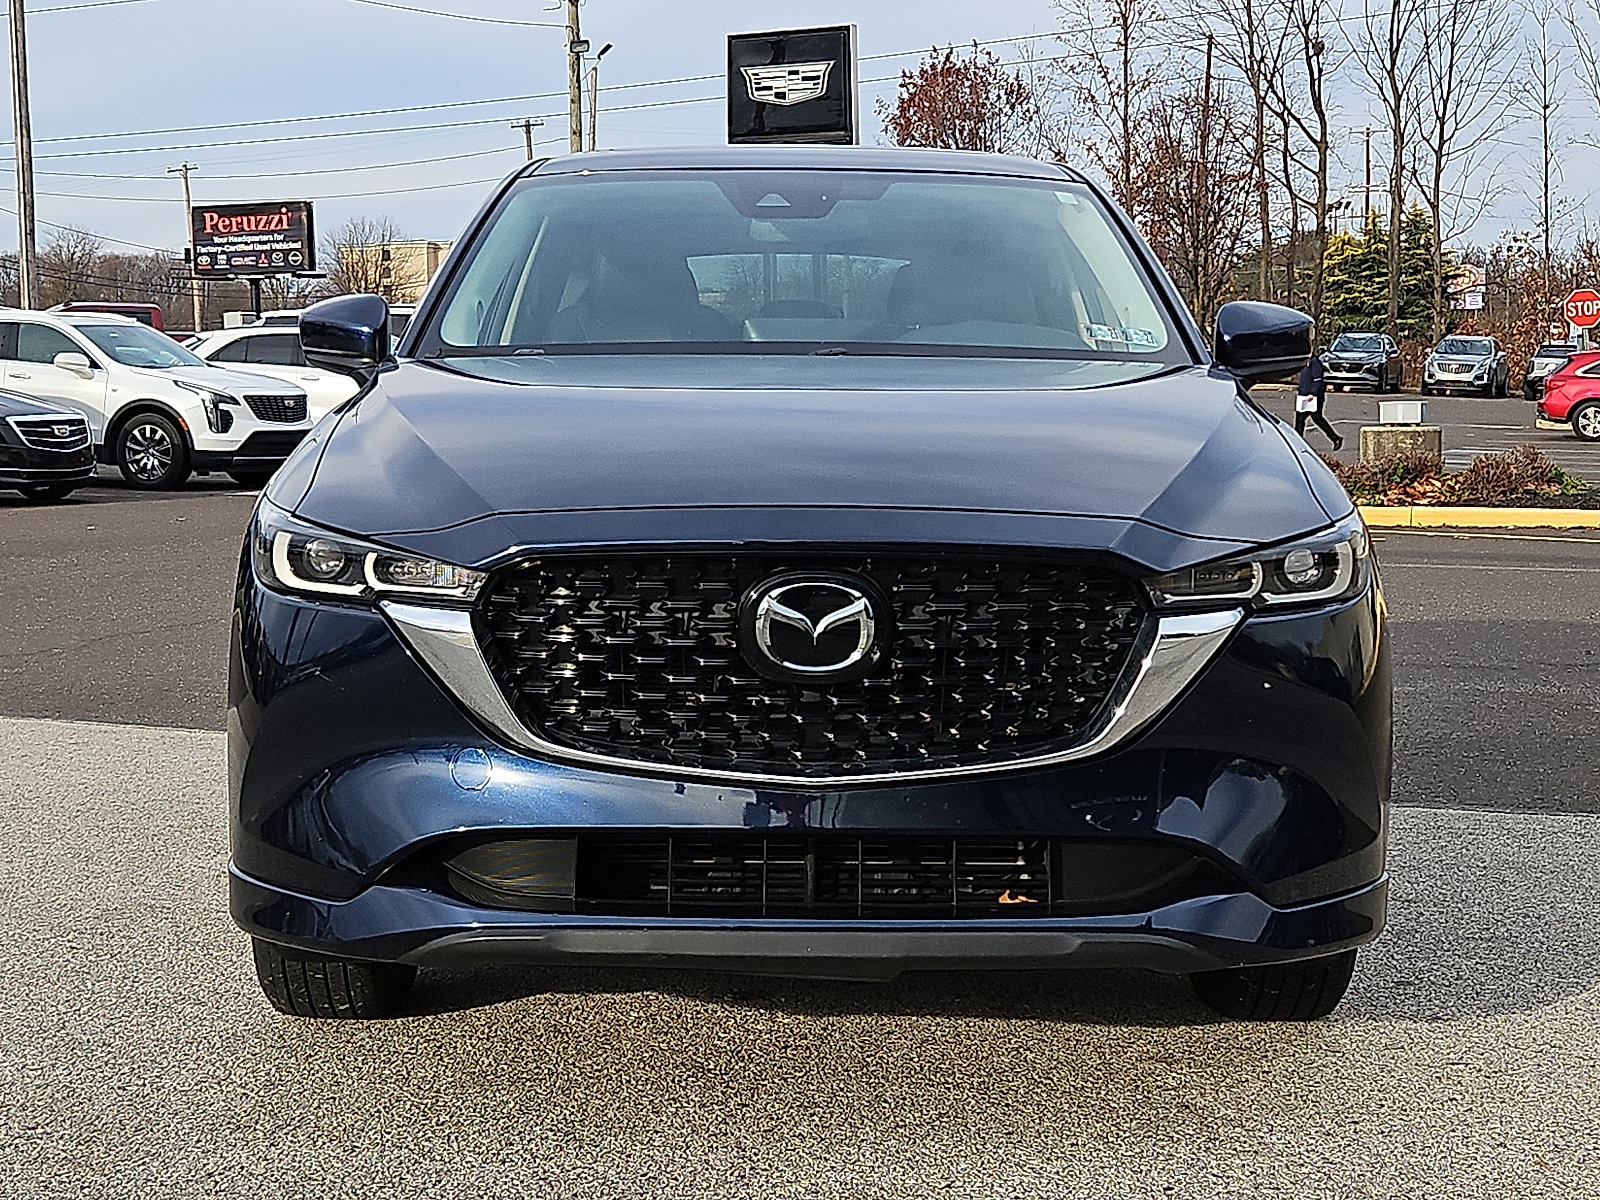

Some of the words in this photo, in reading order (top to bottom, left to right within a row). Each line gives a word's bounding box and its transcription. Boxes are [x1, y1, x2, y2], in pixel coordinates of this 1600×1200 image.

[213, 236, 228, 244] Your
[229, 234, 273, 243] Headquarters
[274, 233, 284, 241] for
[1567, 300, 1600, 317] STOP
